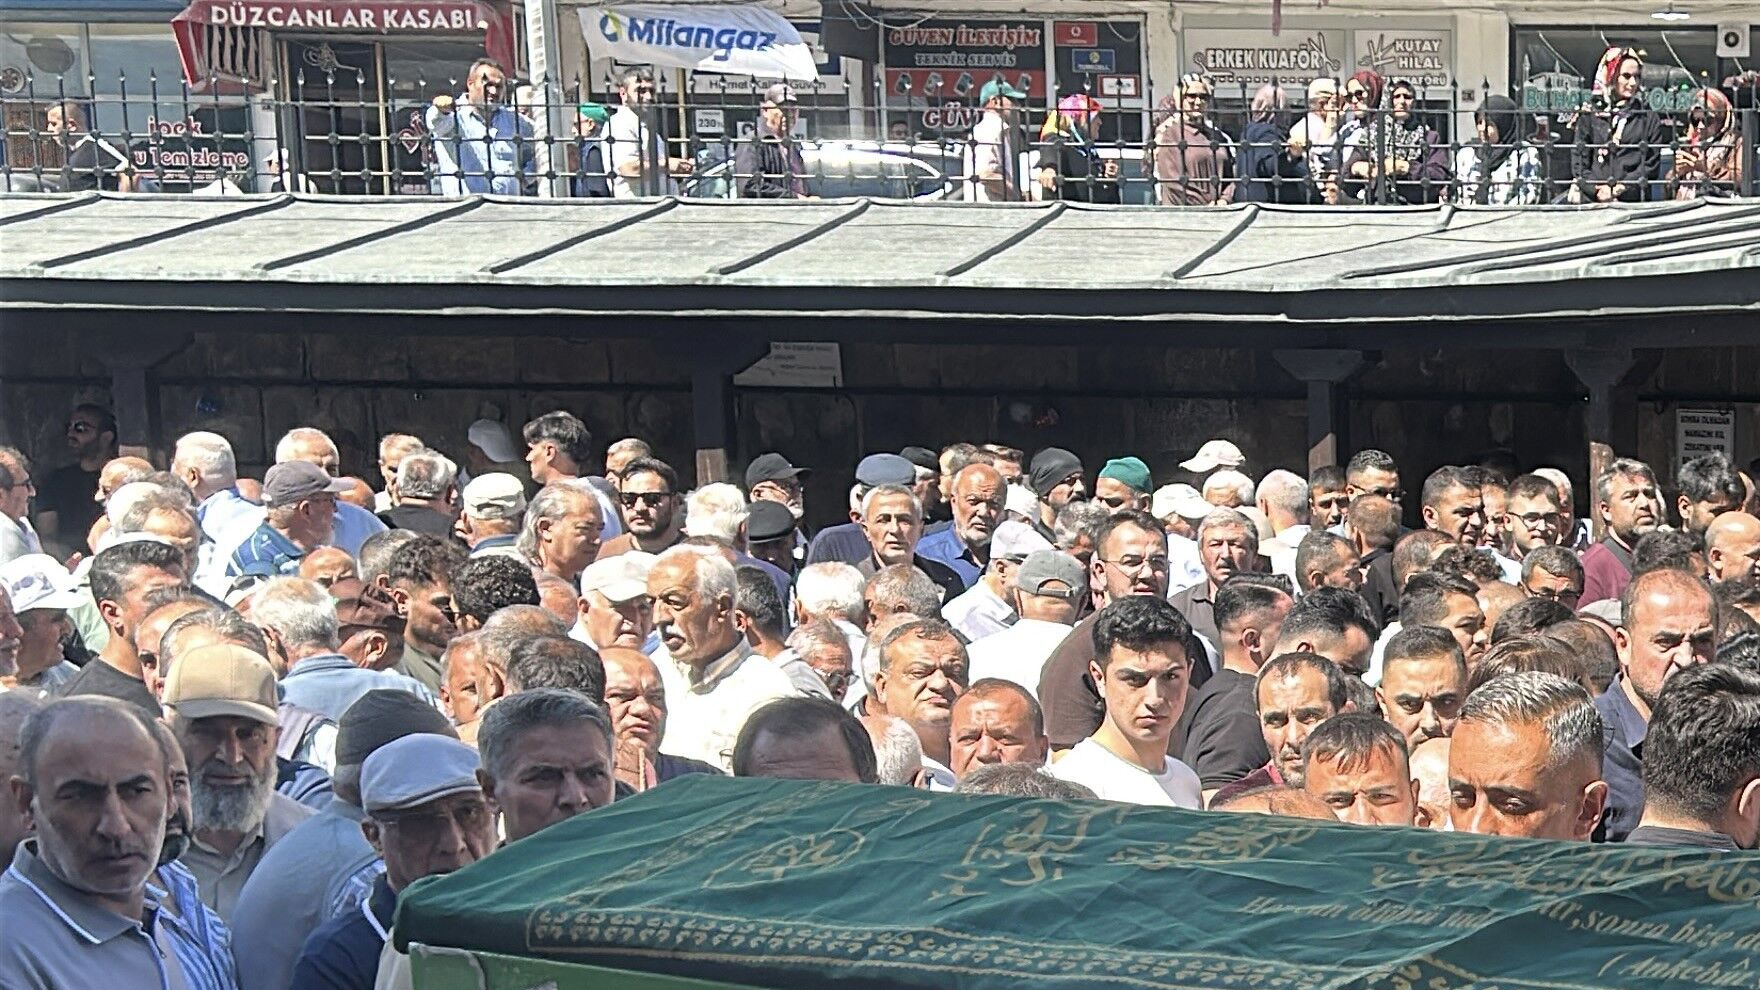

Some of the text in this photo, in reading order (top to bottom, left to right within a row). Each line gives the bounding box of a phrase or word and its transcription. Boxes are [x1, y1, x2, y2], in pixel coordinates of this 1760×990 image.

[211, 1, 473, 29] DÜZCANLAR KASABI
[627, 16, 777, 61] Milangaz
[889, 24, 1041, 49] GÜVEN İLETİŞİM
[1394, 39, 1441, 52] KUTAY
[1207, 48, 1253, 70] ERKEK
[1398, 54, 1443, 69] HİLAL
